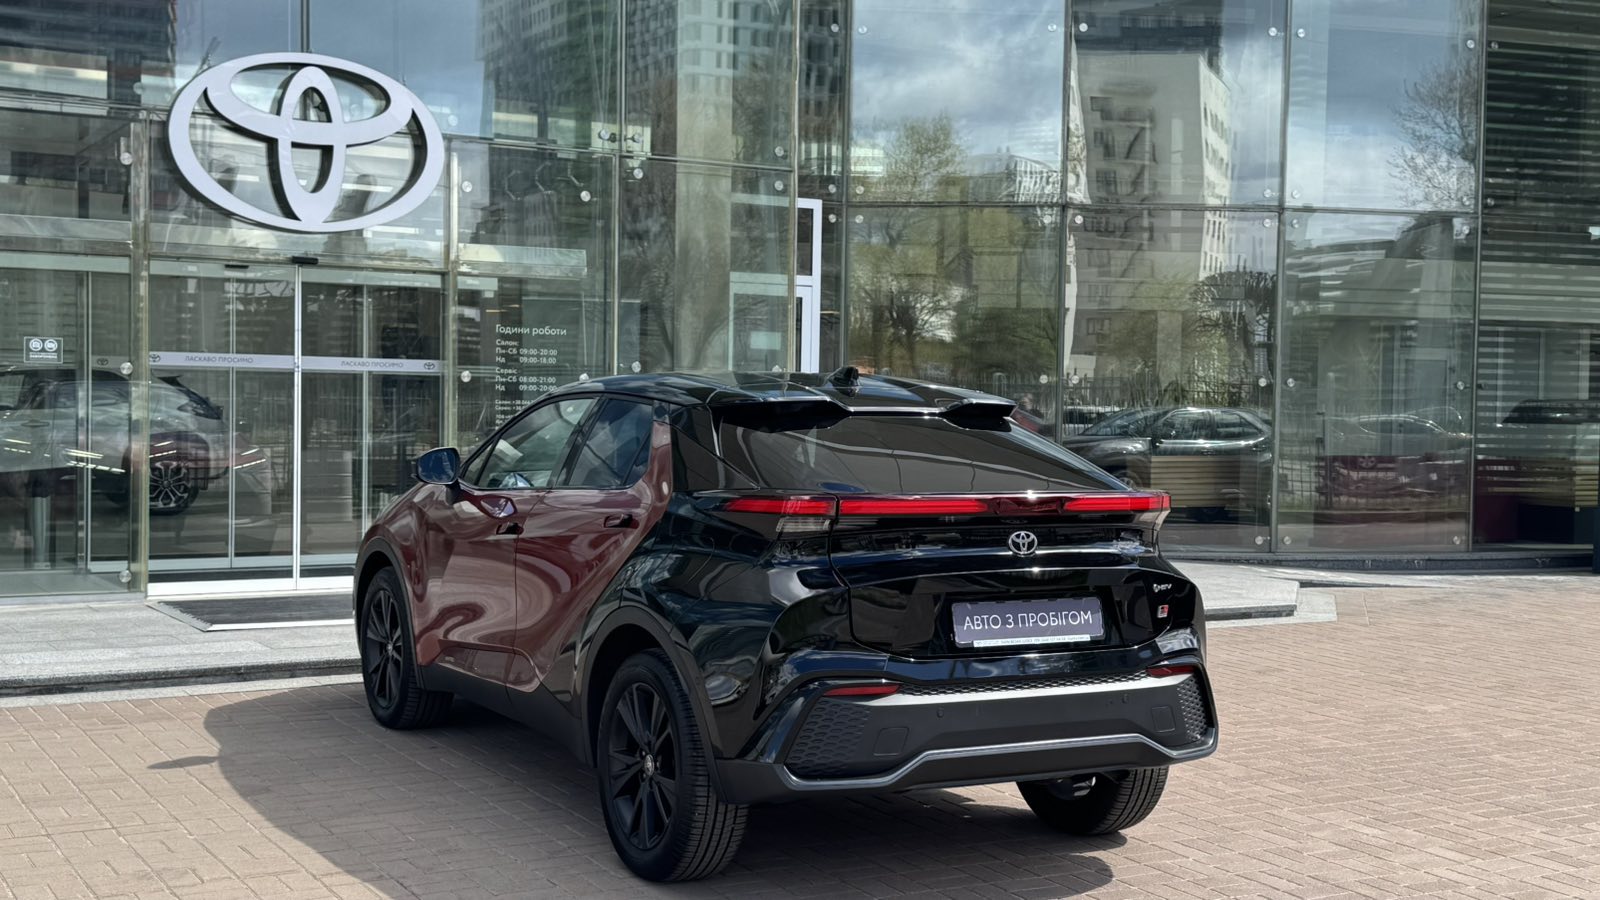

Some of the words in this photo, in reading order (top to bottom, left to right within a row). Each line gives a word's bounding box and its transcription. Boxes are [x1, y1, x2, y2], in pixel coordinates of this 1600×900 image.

[495, 324, 530, 335] Години
[532, 325, 567, 337] роботи
[519, 348, 558, 356] 09:00-20:00
[218, 356, 254, 364] ПРОСИМО
[341, 360, 370, 368] ЛАСКАВО
[963, 613, 1002, 631] АВТО
[1018, 610, 1093, 628] ПРОБІГОМ
